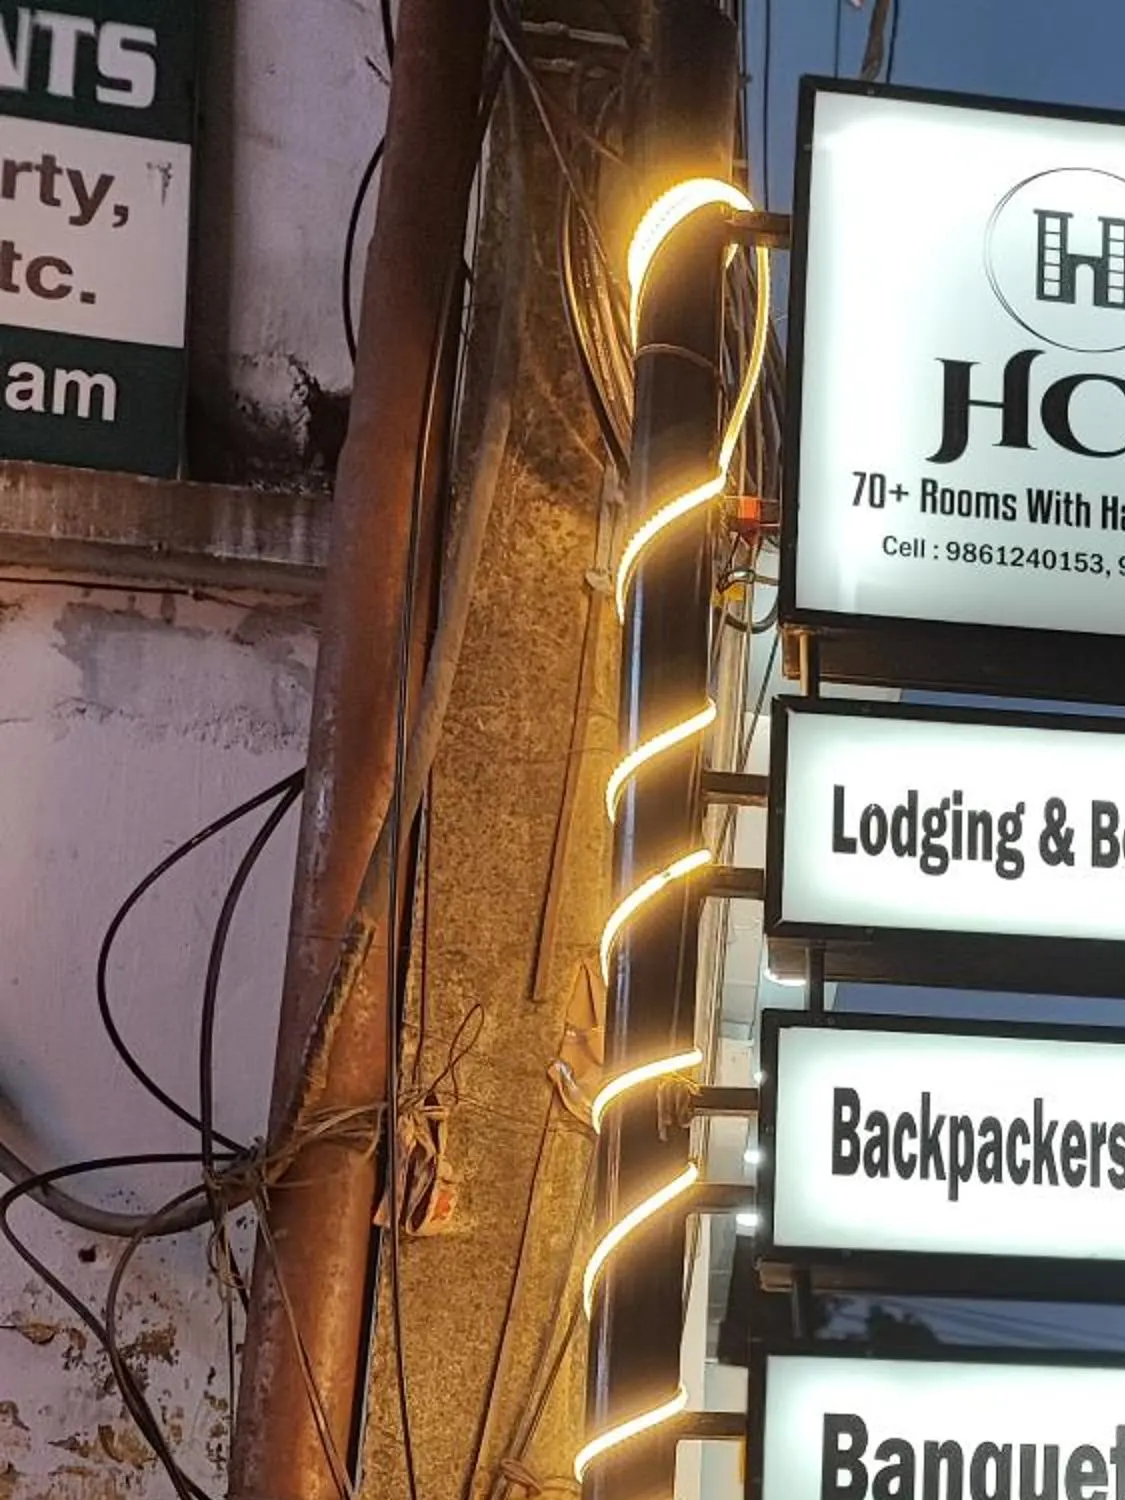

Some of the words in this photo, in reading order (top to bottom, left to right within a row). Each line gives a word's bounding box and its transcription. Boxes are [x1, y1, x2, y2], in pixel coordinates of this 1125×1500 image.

[5, 360, 118, 422] am
[851, 470, 910, 511] 70+
[919, 477, 1018, 523] Rooms
[1025, 486, 1092, 530] With
[881, 534, 926, 559] Cell
[944, 540, 1112, 580] 9861240153,
[831, 784, 1026, 881] Lodging
[1038, 796, 1076, 868] &
